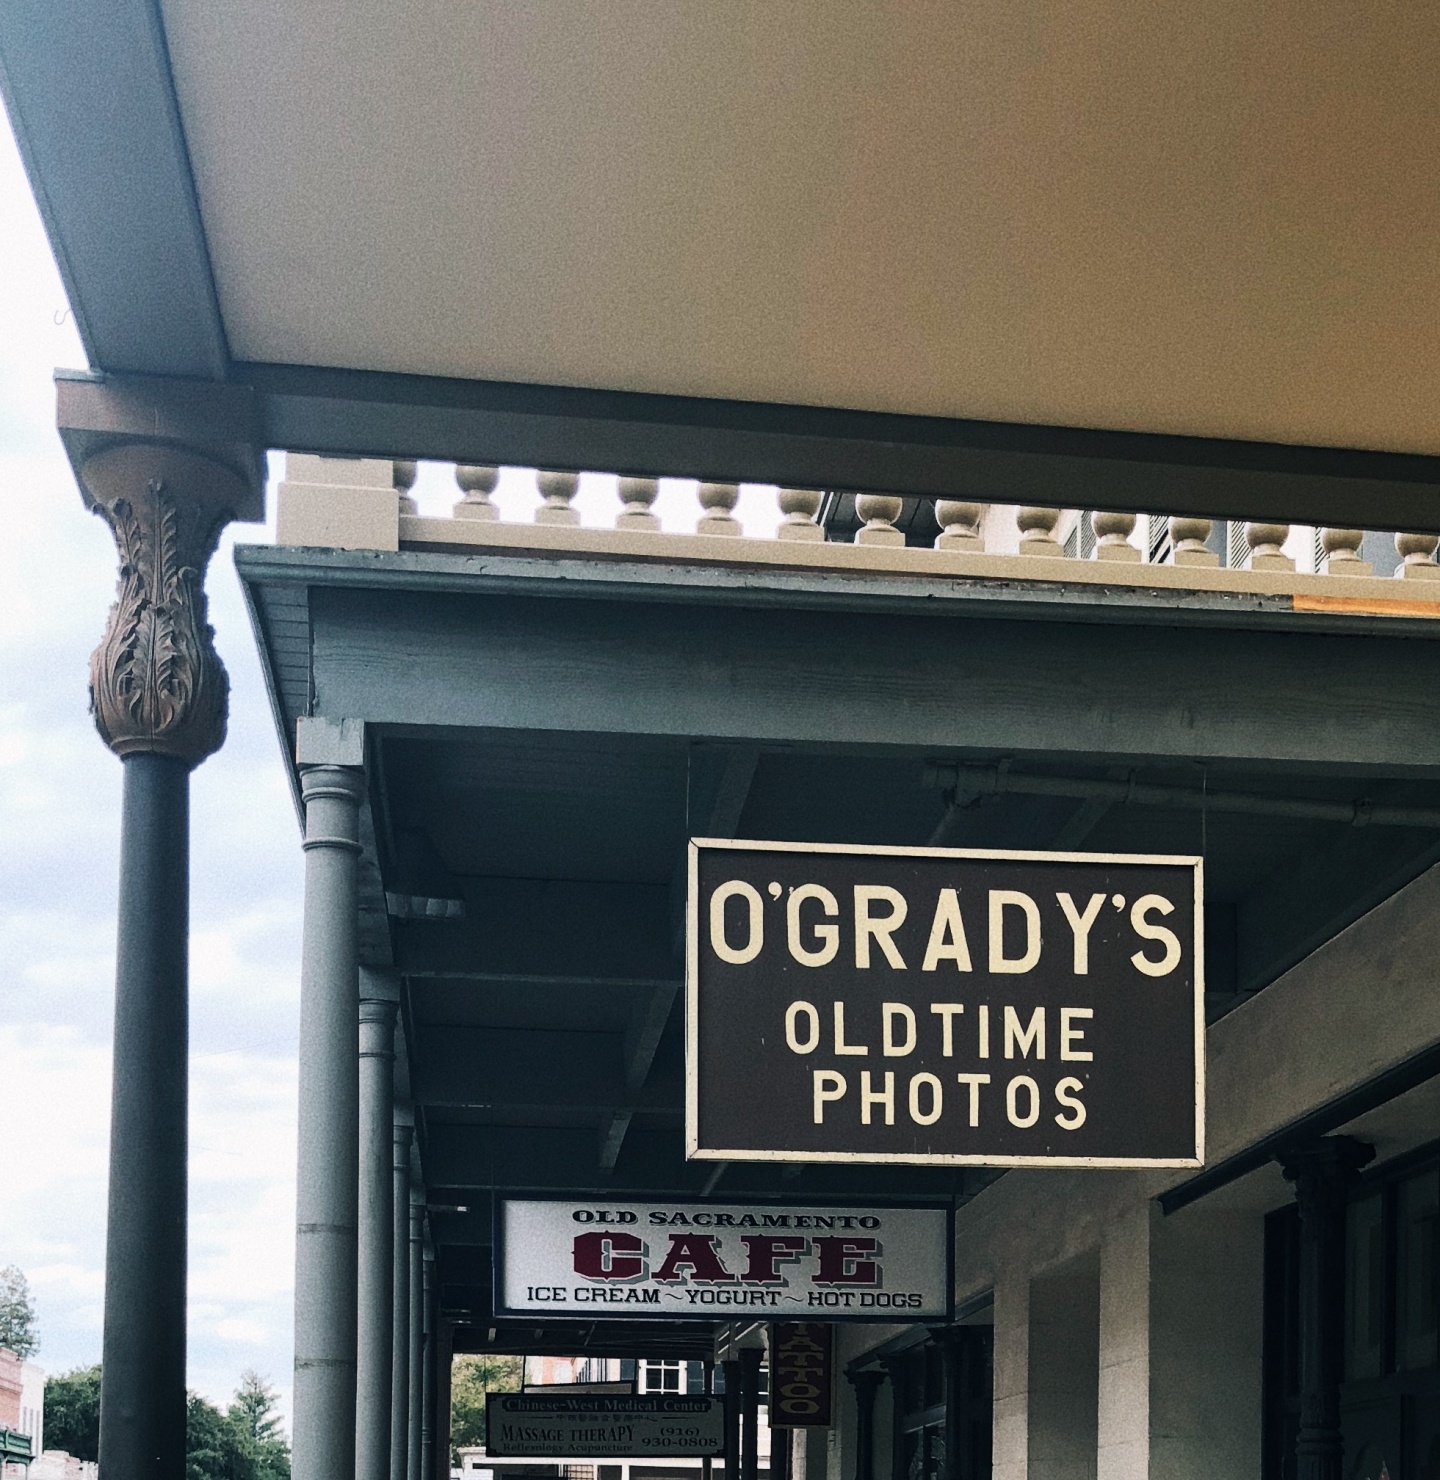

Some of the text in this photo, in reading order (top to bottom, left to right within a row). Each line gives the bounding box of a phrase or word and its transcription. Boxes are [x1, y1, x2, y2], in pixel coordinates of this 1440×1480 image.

[709, 879, 1182, 978] O'GRADY'S
[785, 1000, 1094, 1062] OLDTIME
[812, 1069, 1088, 1131] PHOTOS
[572, 1209, 881, 1230] OLD SACRAMENTO
[571, 1229, 884, 1290] CAFE
[526, 1286, 923, 1309] ICE CREAM YOGURT HOT DOGS
[506, 1399, 708, 1411] Chinese-West Medical Center
[502, 1424, 635, 1442] MASSAGE THERAPY
[641, 1437, 718, 1447] 930-0808
[660, 1427, 700, 1437] (916)
[503, 1443, 633, 1453] Reflexology Acupuncture
